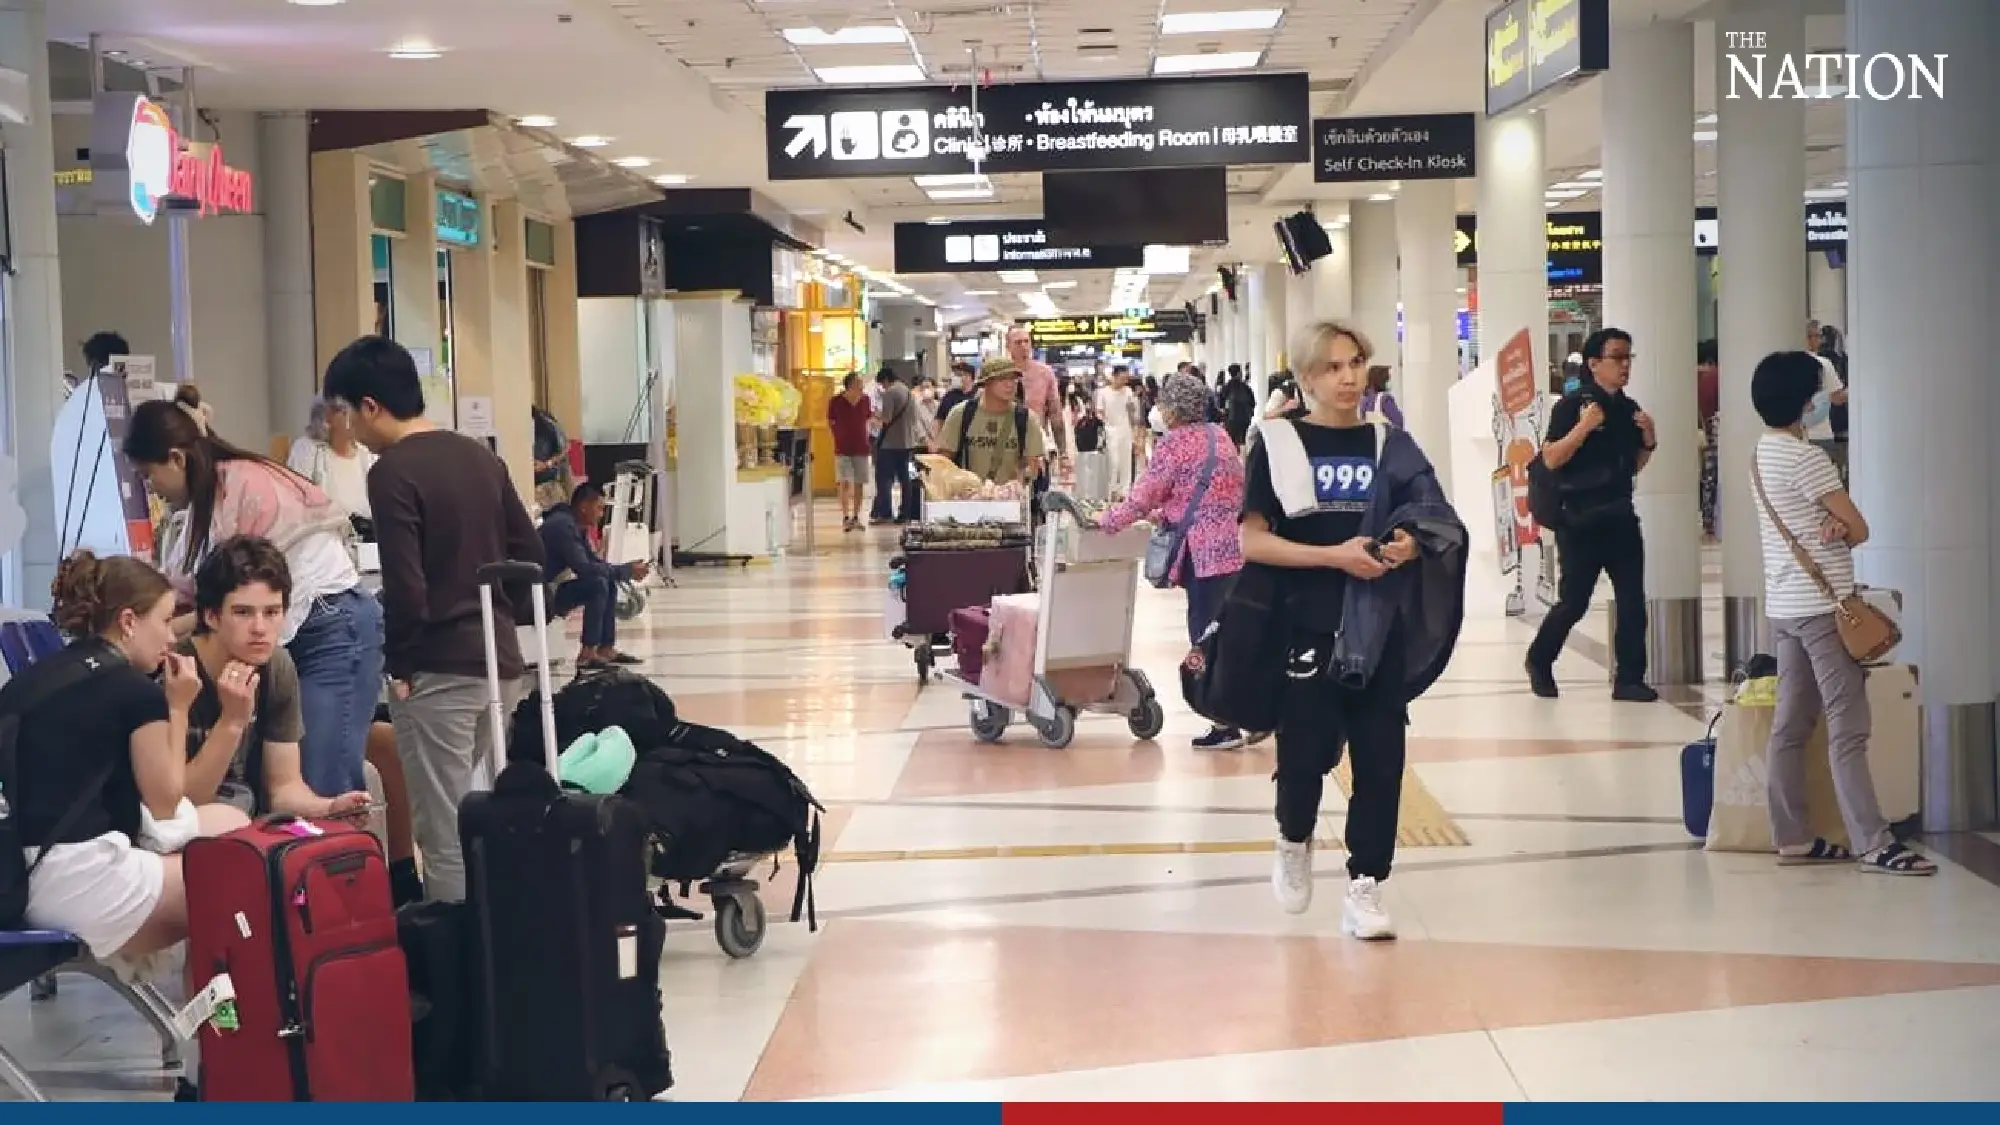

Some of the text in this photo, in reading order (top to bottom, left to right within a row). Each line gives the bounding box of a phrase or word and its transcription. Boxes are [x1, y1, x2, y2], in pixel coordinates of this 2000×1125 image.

[1036, 131, 1154, 151] Breastfeeding
[1159, 128, 1210, 146] Room
[1324, 153, 1467, 173] Self Check-In Kiosk
